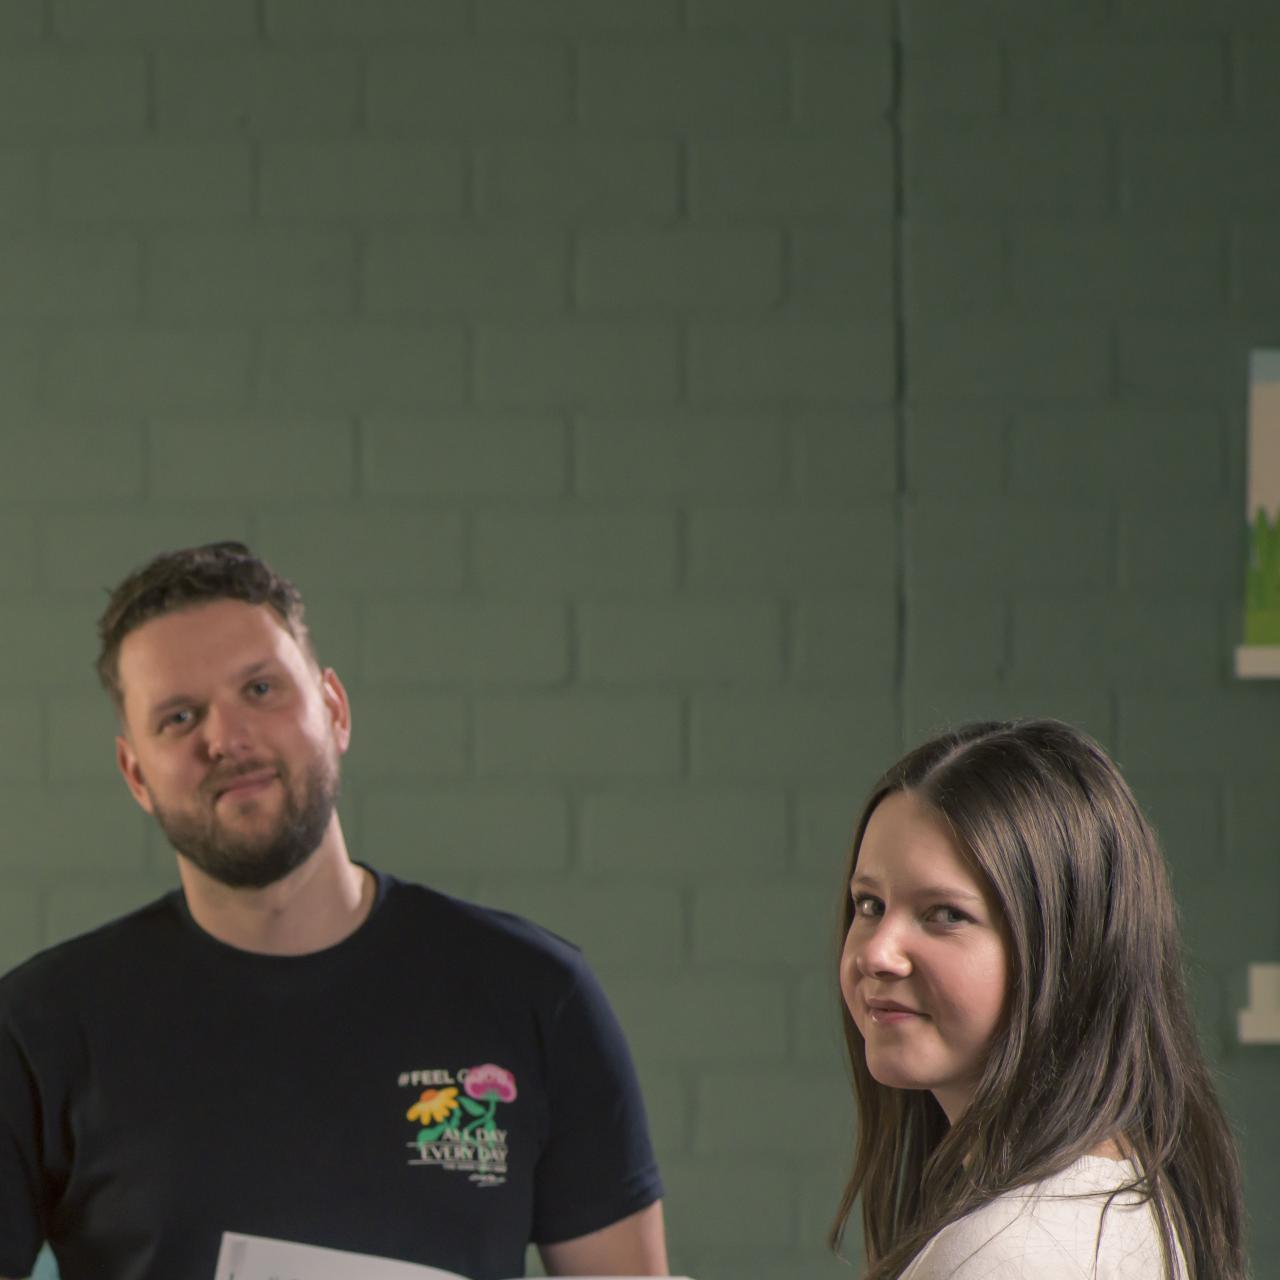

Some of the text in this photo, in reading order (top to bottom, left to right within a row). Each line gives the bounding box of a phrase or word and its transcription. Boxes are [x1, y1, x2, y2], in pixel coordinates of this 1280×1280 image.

[398, 1069, 455, 1086] #FEEL
[442, 1127, 508, 1144] ALL DAY
[421, 1144, 508, 1163] EVERY DAY
